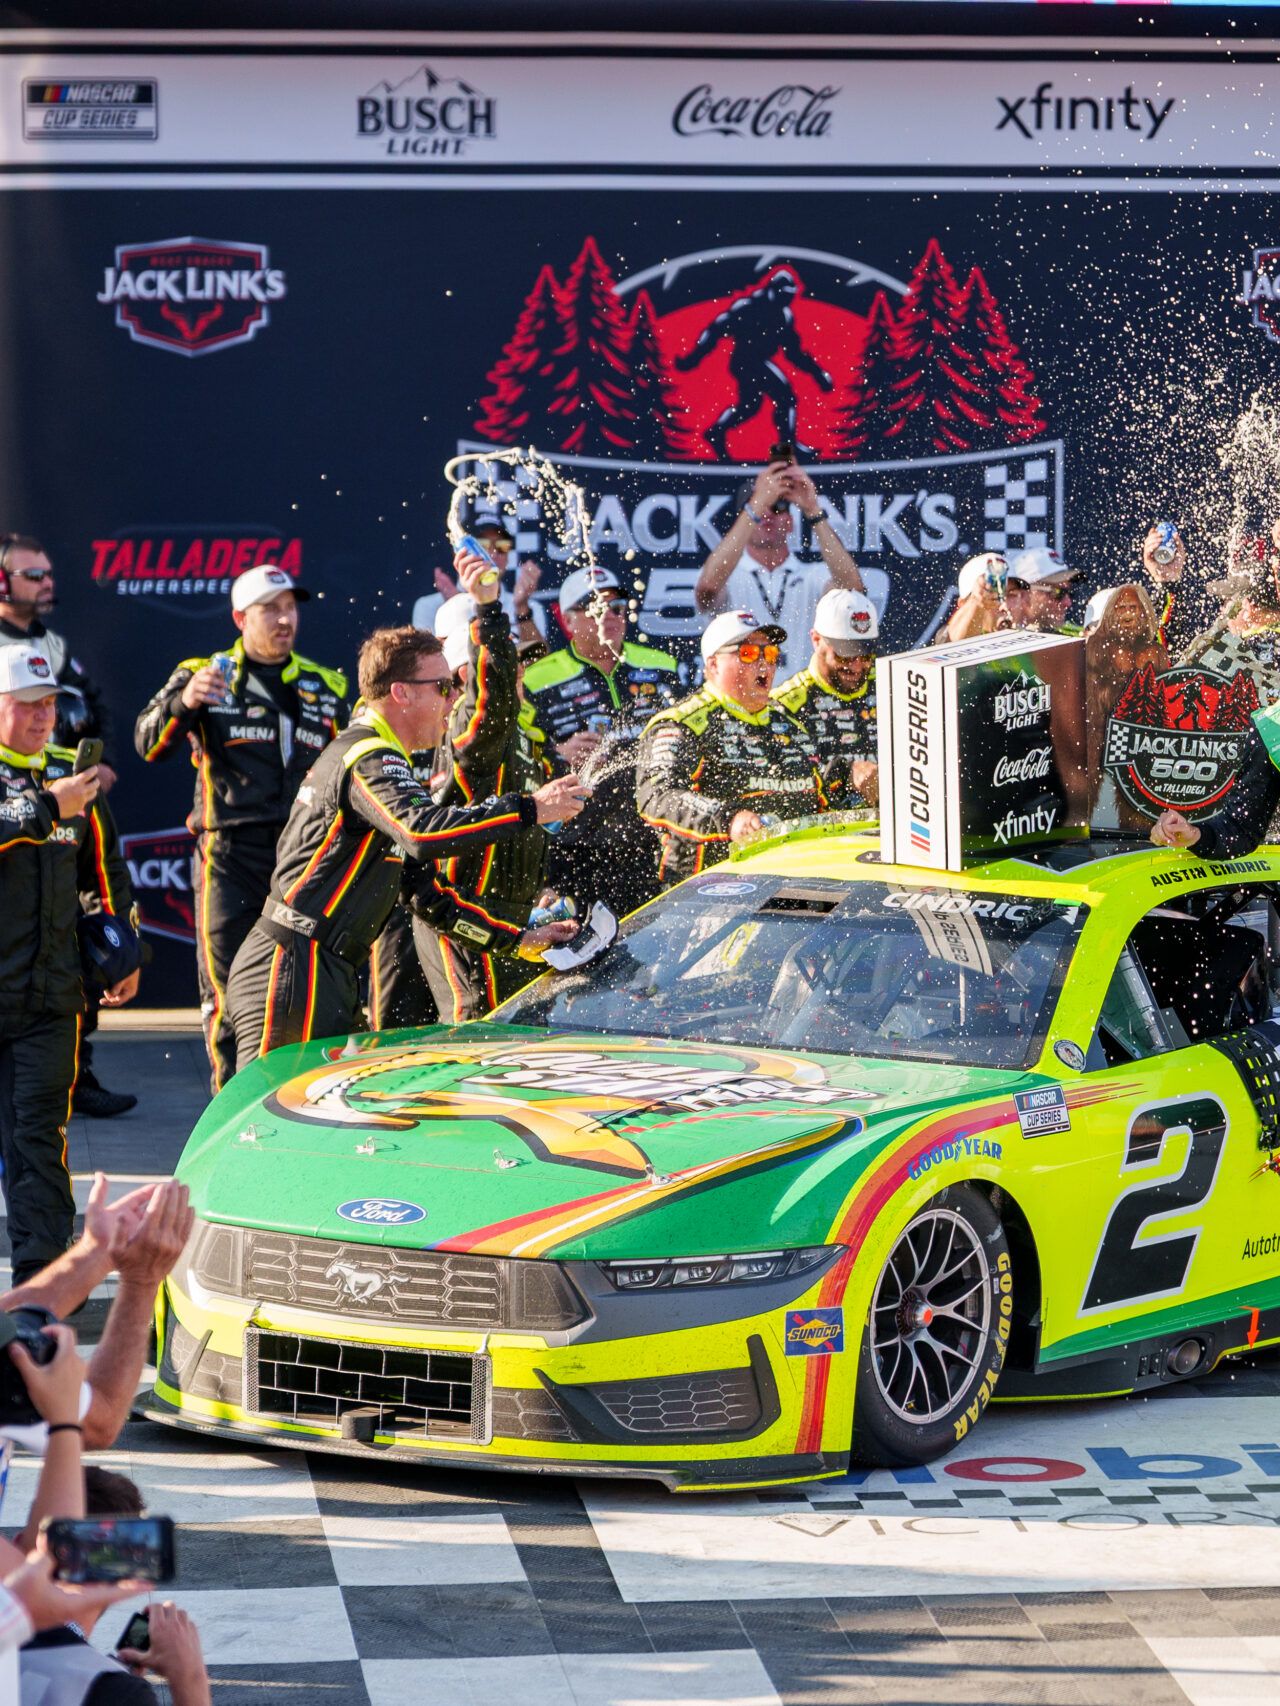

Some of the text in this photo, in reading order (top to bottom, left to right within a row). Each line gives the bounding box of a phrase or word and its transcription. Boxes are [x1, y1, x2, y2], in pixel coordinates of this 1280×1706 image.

[66, 84, 137, 103] NASCAR
[43, 109, 138, 129] CUP SERIES
[357, 97, 497, 138] BUSCH
[672, 83, 843, 138] Coca-Cola
[996, 82, 1175, 140] xfinity
[386, 138, 465, 156] LIGHT
[97, 267, 286, 302] JACK LINK'S
[91, 538, 304, 577] TALLADEGA
[116, 578, 233, 596] SUPERSPEE
[941, 632, 1048, 663] CUP SERIES
[993, 682, 1051, 723] BUSCH
[1003, 712, 1041, 731] LIGHT
[907, 669, 931, 823] CUP SERIES
[1129, 733, 1240, 761] JACK LINK'S
[993, 746, 1053, 788] Coca-Cola
[1149, 758, 1219, 782] 500
[1154, 782, 1207, 795] at TALLADEGA
[993, 805, 1057, 845] xfinity
[126, 859, 190, 891] ACK
[1151, 858, 1272, 888] AUSTIN CINDRIC
[881, 892, 1033, 922] CINDRIC
[1029, 1090, 1058, 1109] NASCAR
[1027, 1111, 1062, 1128] CUP SERIES
[906, 1135, 1003, 1182] GOODYEAR
[350, 1202, 407, 1223] Ford
[1082, 1092, 1230, 1314] 2
[790, 1325, 839, 1341] SUNOCO
[954, 1251, 1014, 1441] GOODYEAR
